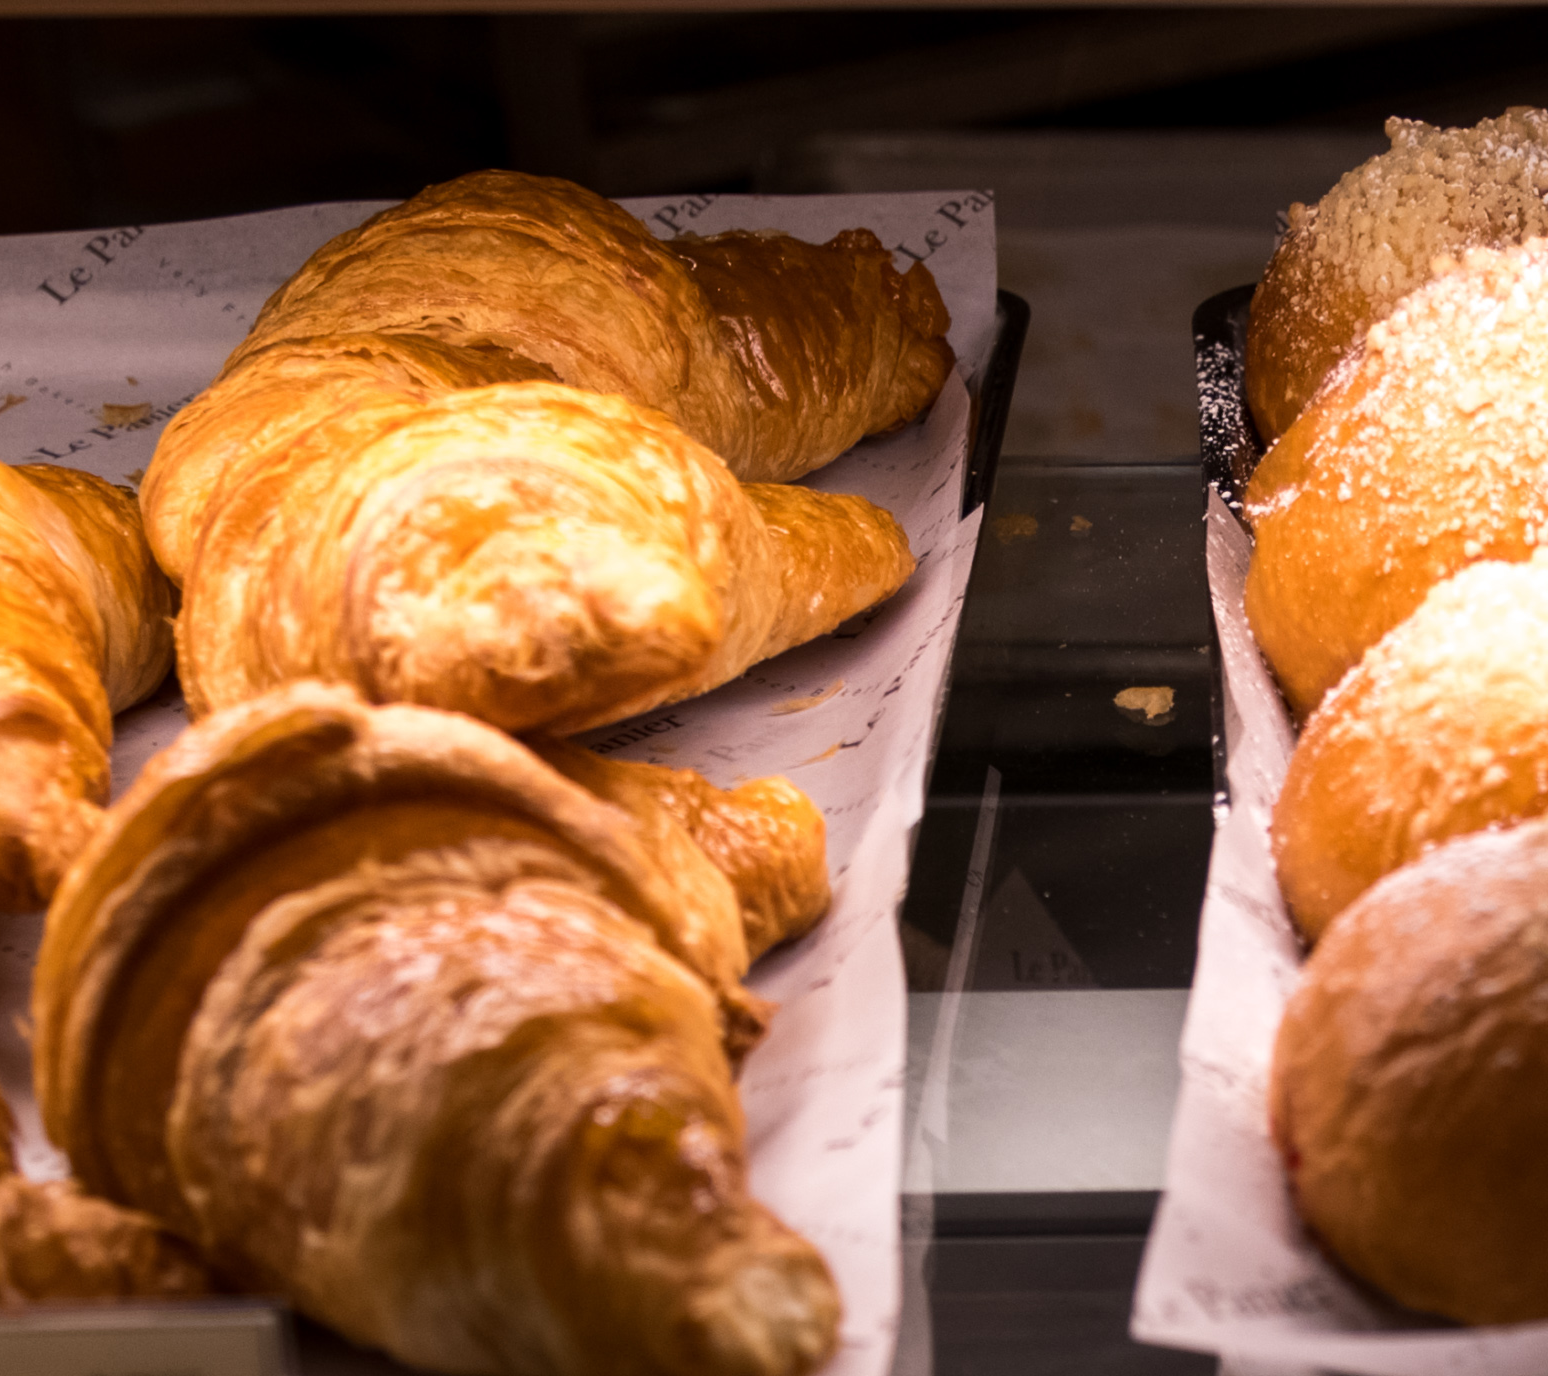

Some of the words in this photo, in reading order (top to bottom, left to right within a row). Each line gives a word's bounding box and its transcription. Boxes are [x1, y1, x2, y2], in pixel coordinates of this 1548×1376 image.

[896, 226, 949, 264] Le
[35, 264, 94, 307] Le
[34, 437, 93, 460] Le
[589, 713, 685, 754] anier
